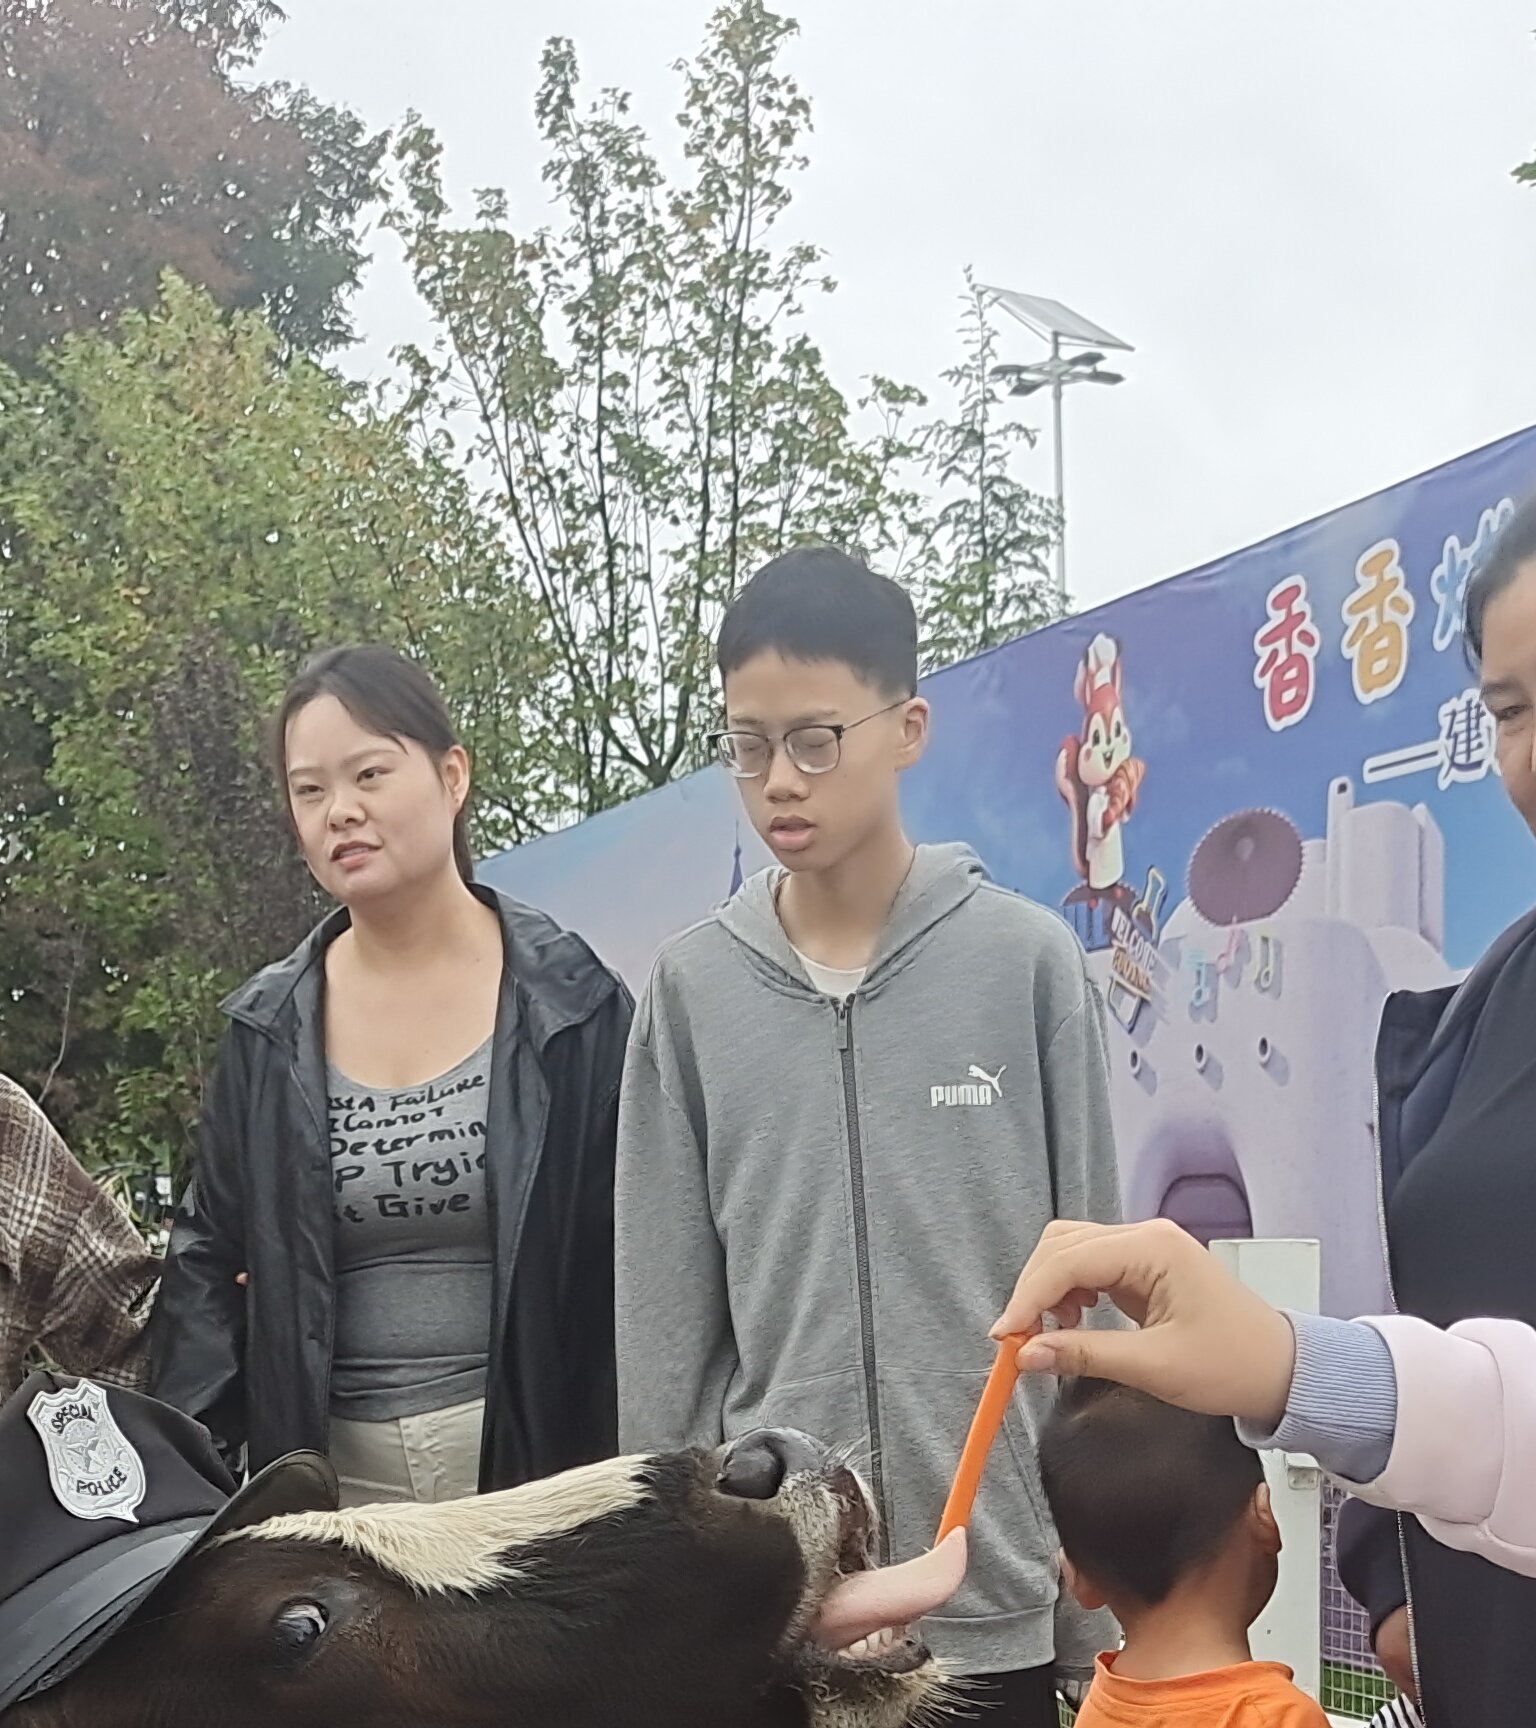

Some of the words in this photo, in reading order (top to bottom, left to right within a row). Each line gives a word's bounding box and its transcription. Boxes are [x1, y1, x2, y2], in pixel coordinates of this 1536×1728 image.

[930, 1085, 991, 1108] PUMA
[373, 1194, 470, 1218] Give
[76, 1466, 128, 1496] POLICE
